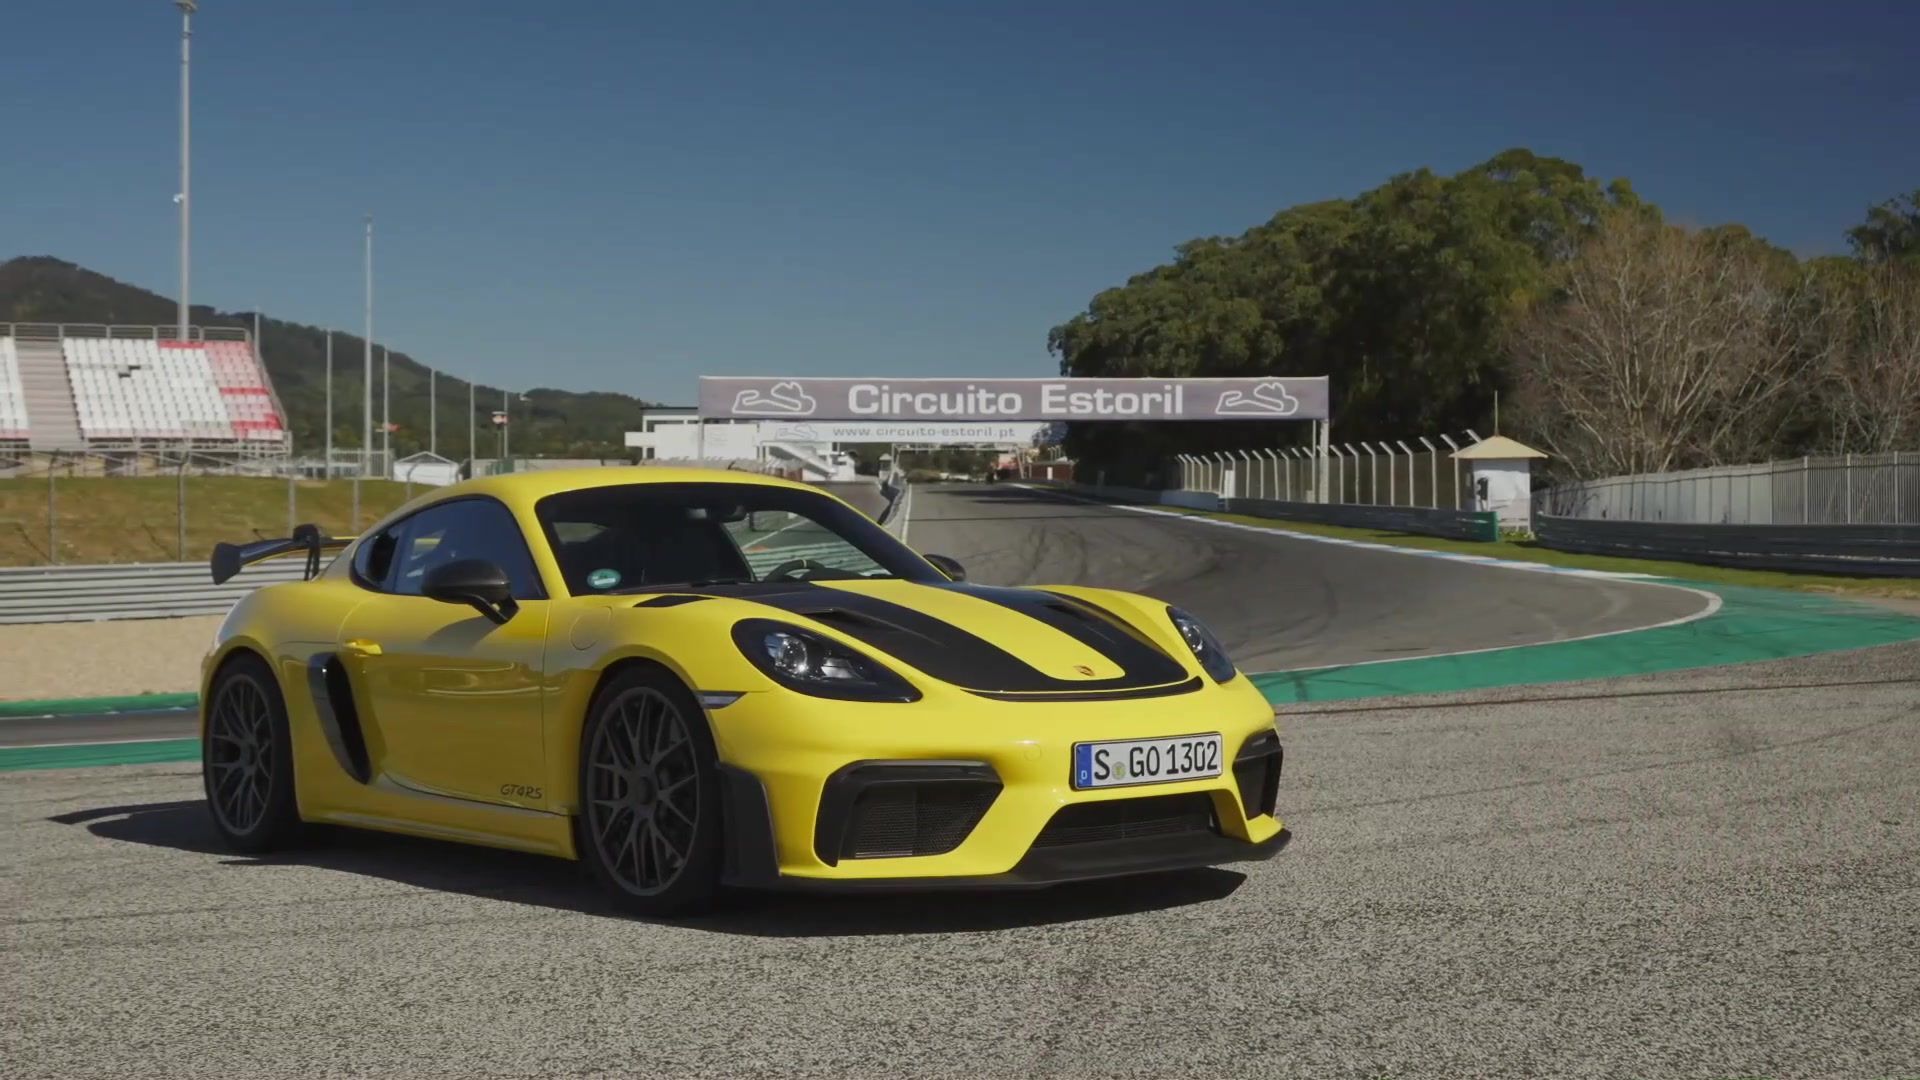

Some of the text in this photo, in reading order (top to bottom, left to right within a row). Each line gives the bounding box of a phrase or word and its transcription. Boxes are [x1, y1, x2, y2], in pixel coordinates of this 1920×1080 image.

[848, 384, 1183, 414] Circuito Estoril
[833, 427, 1015, 438] www.circuito-estoril.pt
[1094, 749, 1111, 781] S
